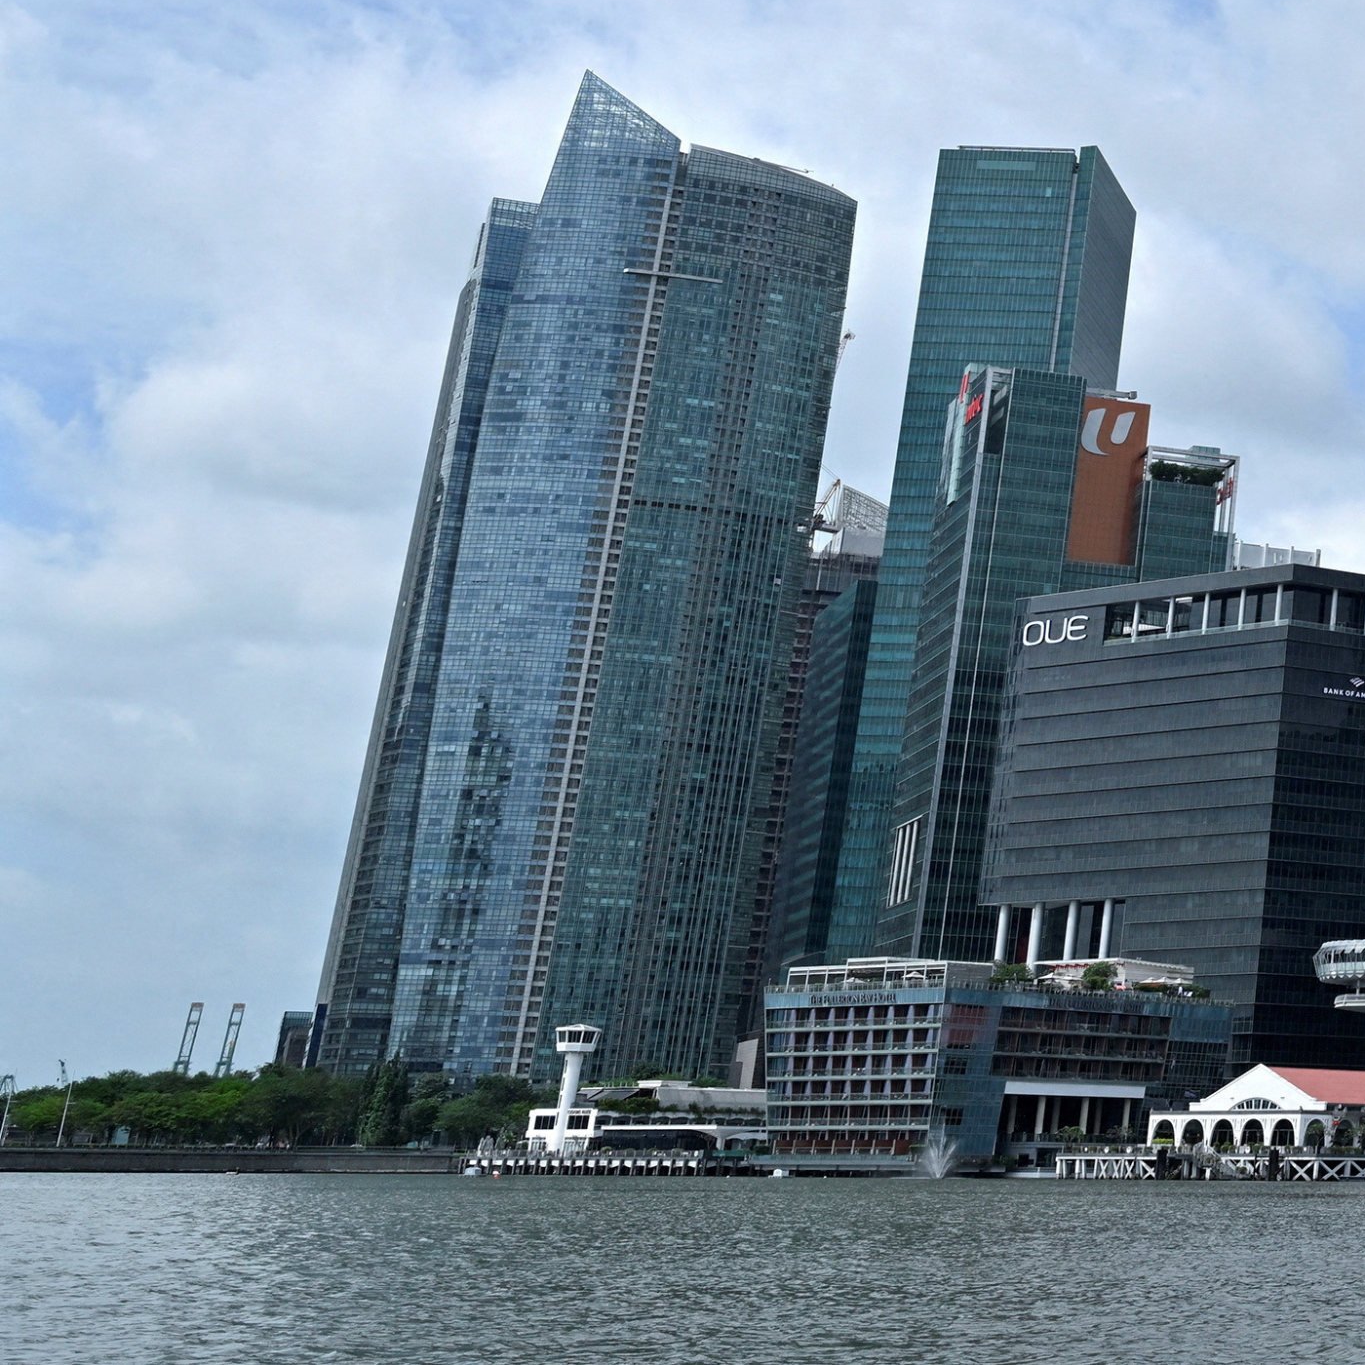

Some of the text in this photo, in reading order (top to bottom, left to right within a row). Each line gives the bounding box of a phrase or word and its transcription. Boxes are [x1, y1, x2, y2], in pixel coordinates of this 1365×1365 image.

[1022, 615, 1089, 647] OUE
[1323, 687, 1344, 696] BANK
[1344, 689, 1355, 697] OF
